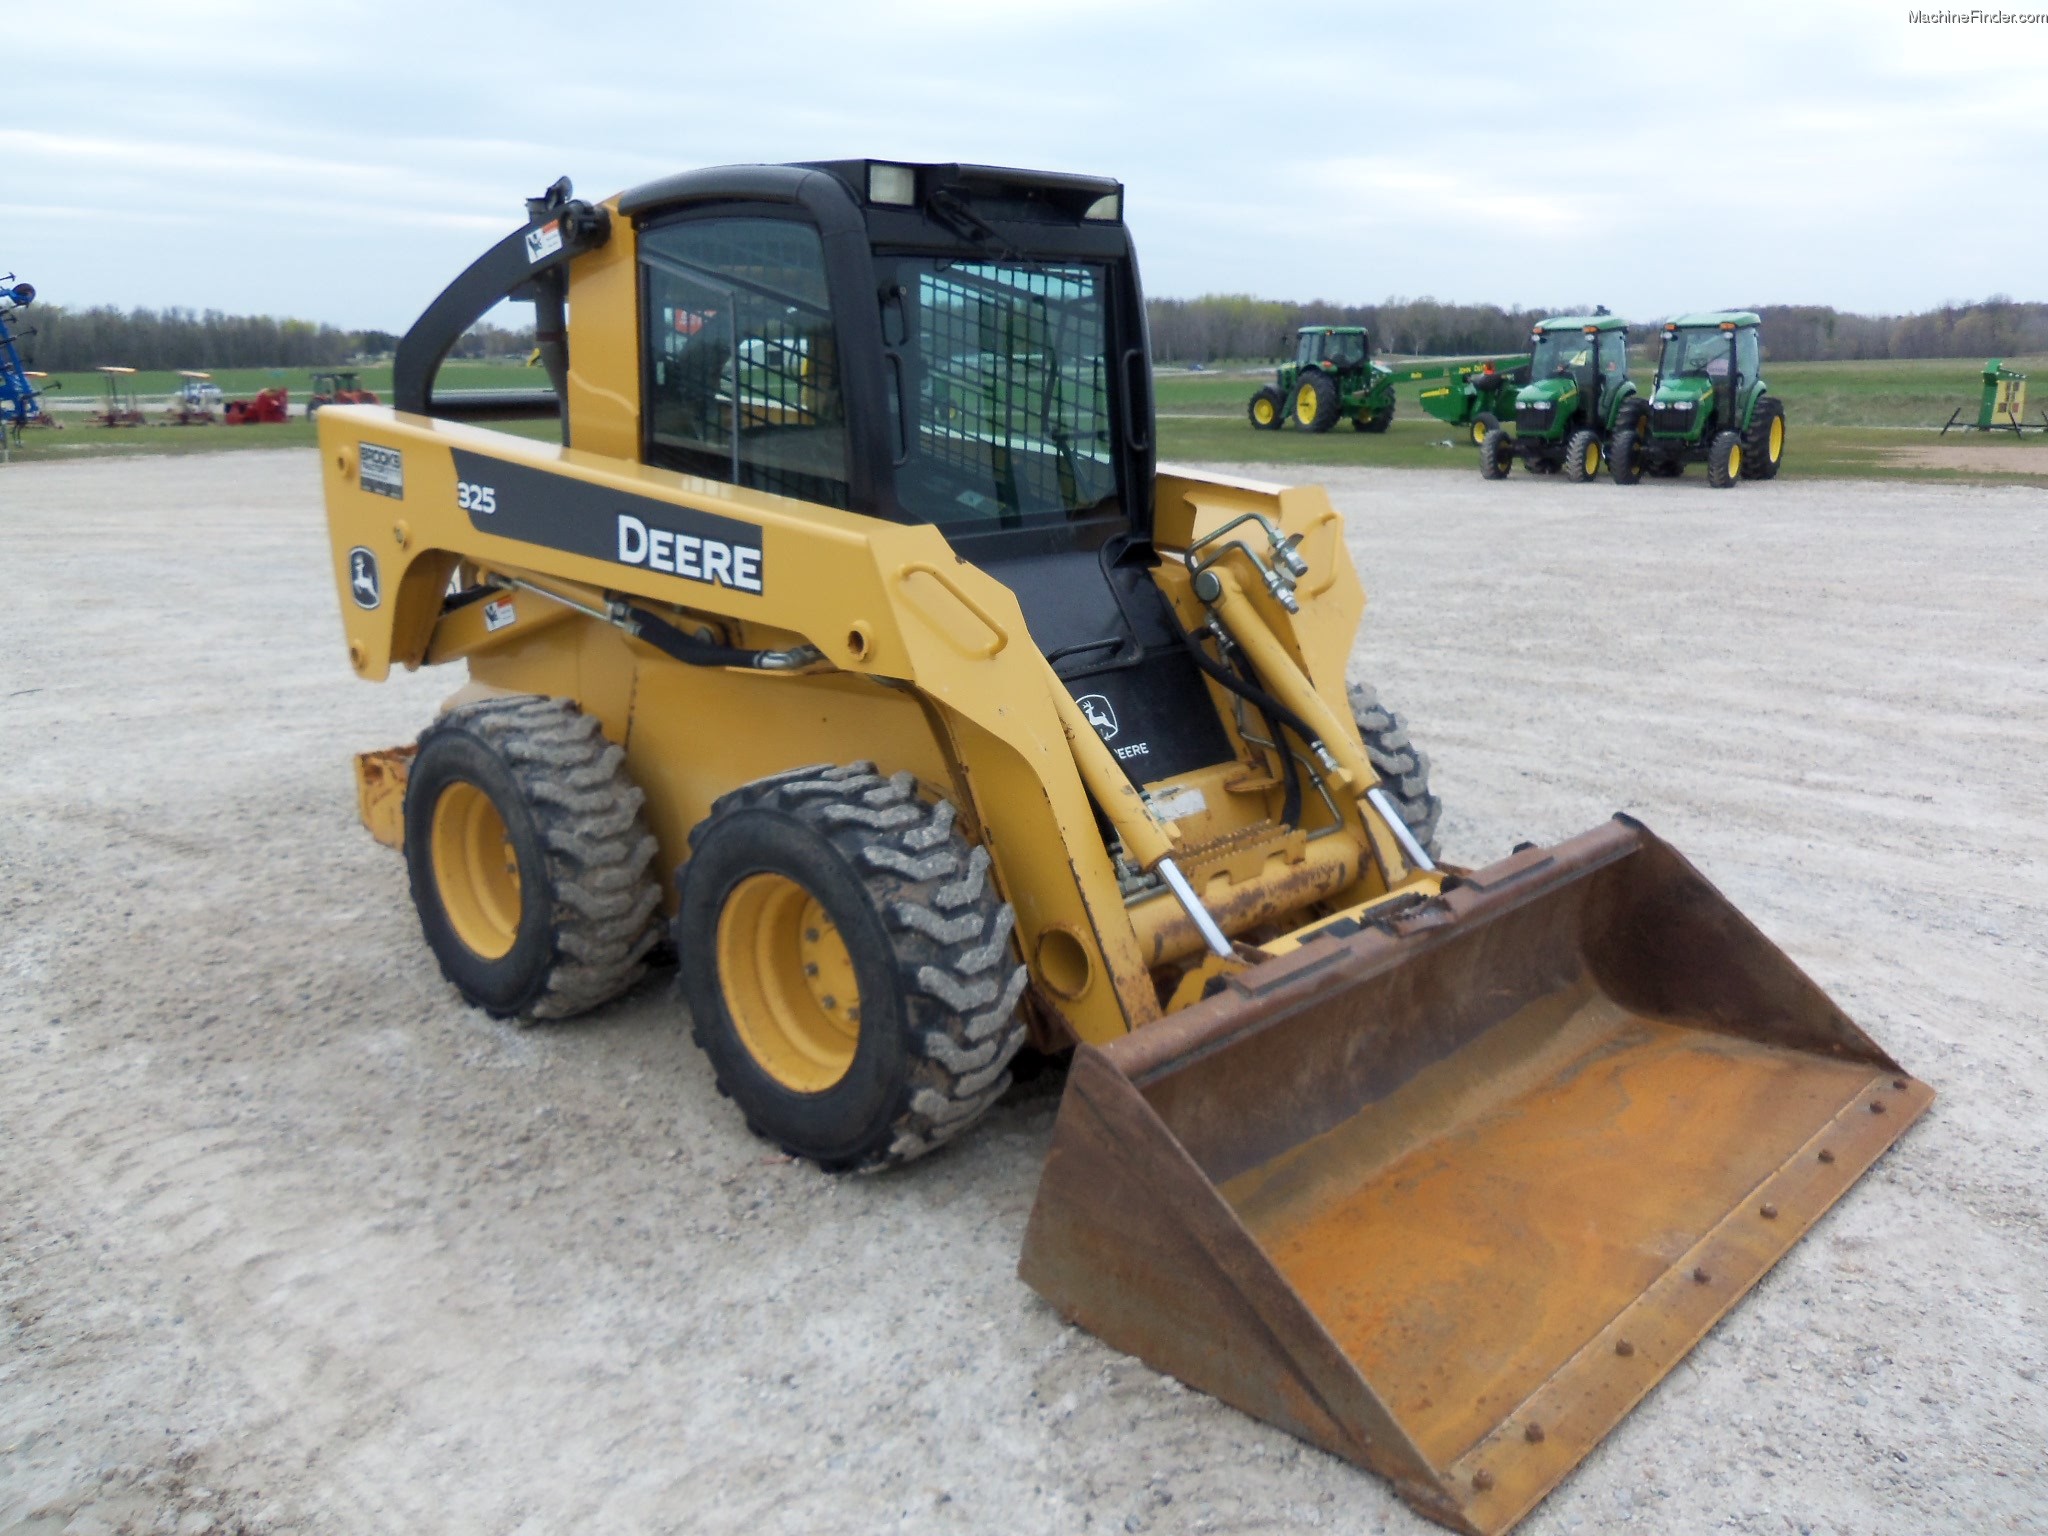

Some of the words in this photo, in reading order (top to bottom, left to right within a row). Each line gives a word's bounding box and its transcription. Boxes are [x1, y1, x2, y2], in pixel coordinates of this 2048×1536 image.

[457, 481, 496, 514] 325
[618, 513, 762, 591] DEERE
[1113, 742, 1150, 759] EERE
